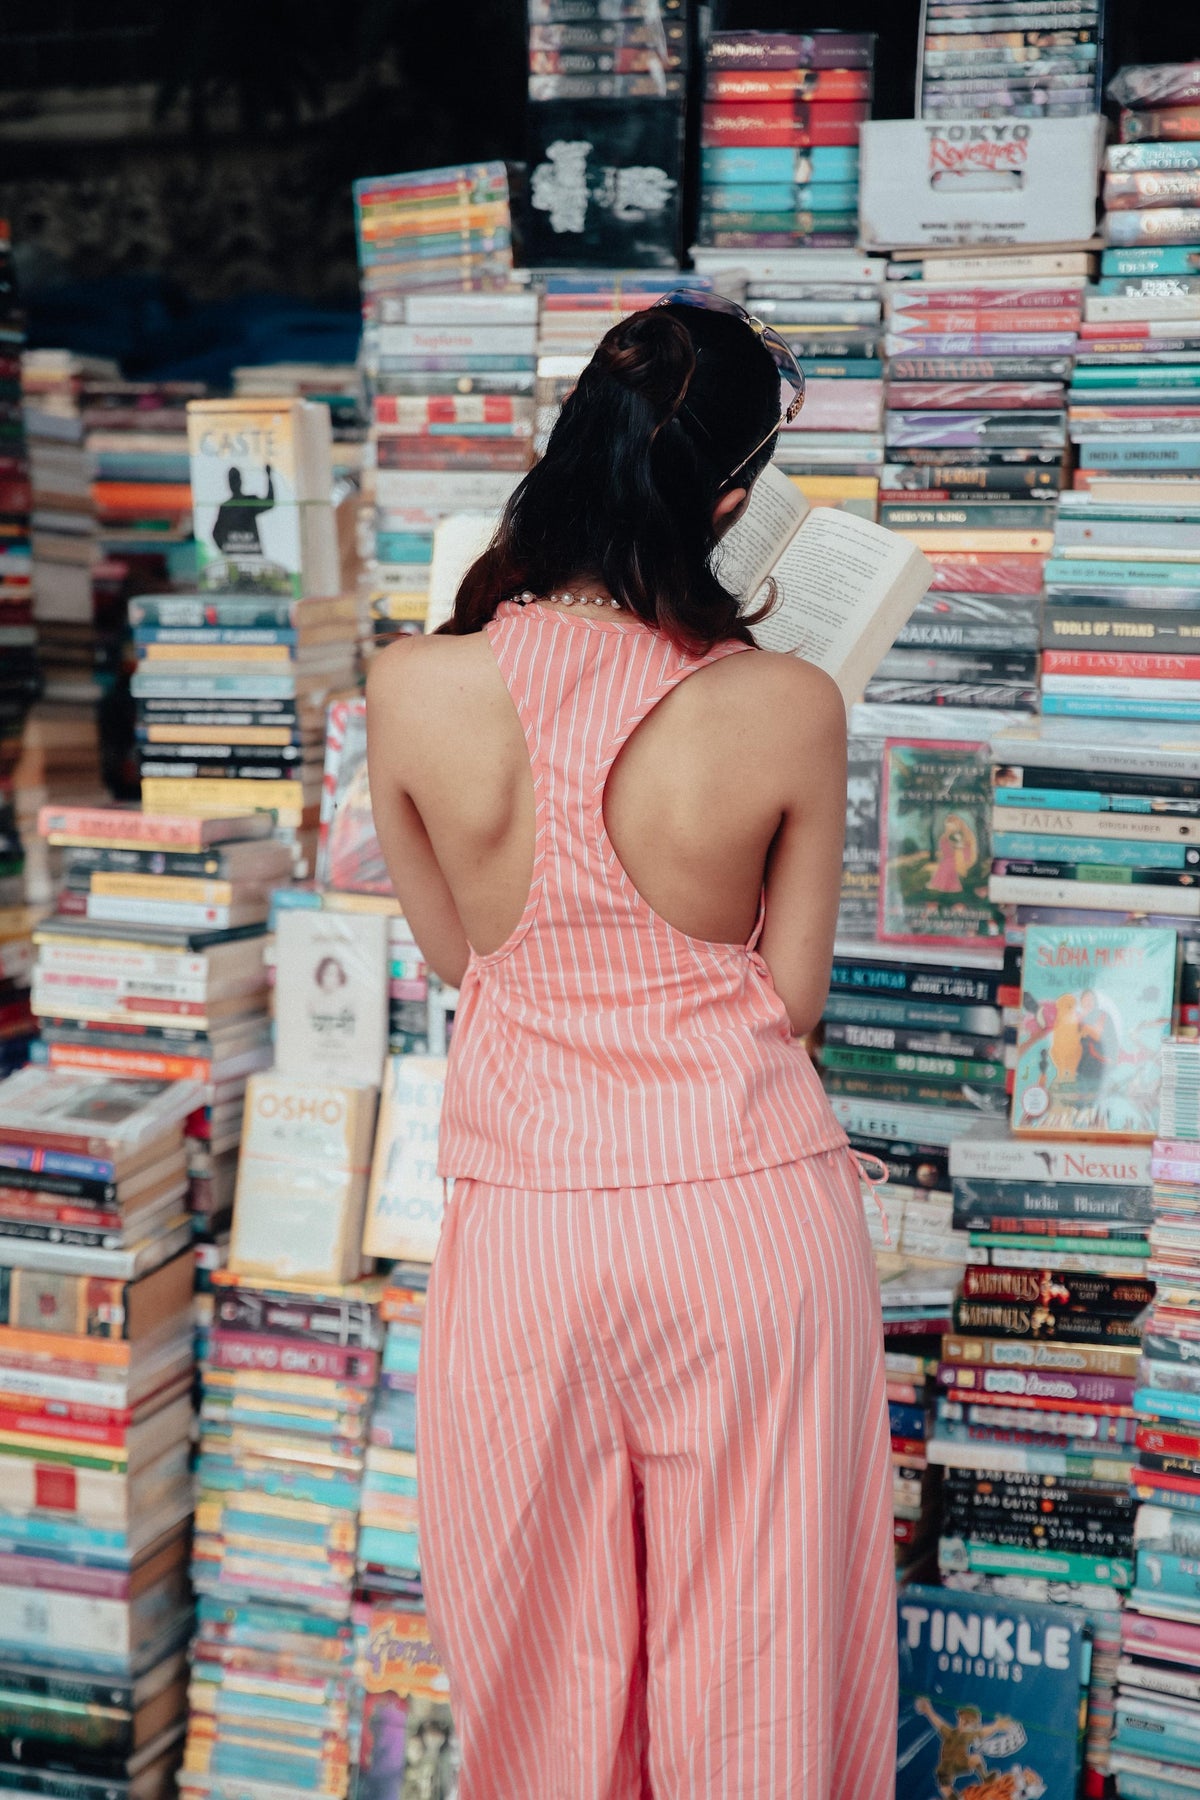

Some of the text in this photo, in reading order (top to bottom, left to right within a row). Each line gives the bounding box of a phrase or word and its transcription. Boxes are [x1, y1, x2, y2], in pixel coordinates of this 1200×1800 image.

[925, 125, 1030, 140] TOKYO
[200, 430, 275, 456] CASTE
[1089, 450, 1179, 460] INDIA UNBOUND
[898, 626, 963, 644] RAKAMI
[1053, 621, 1091, 636] TOOLS
[1092, 621, 1110, 636] OF
[1112, 622, 1155, 637] TITANS
[1088, 656, 1126, 668] LAST
[1132, 657, 1186, 671] QUEEN
[1020, 813, 1073, 829] TATAS
[1036, 946, 1090, 967] SUDHA
[845, 1025, 895, 1049] TEACHER
[916, 1057, 956, 1075] DAYS
[256, 1094, 342, 1125] OSHO
[857, 1119, 898, 1136] LESS
[1064, 1153, 1138, 1179] Nexus
[376, 1195, 443, 1221] MOV
[1024, 1193, 1121, 1215] India Bharat
[1004, 1473, 1040, 1486] GUYS
[1002, 1497, 1037, 1511] GUYS
[901, 1606, 1071, 1670] TINKLE
[938, 1653, 1023, 1682] ORIGINS
